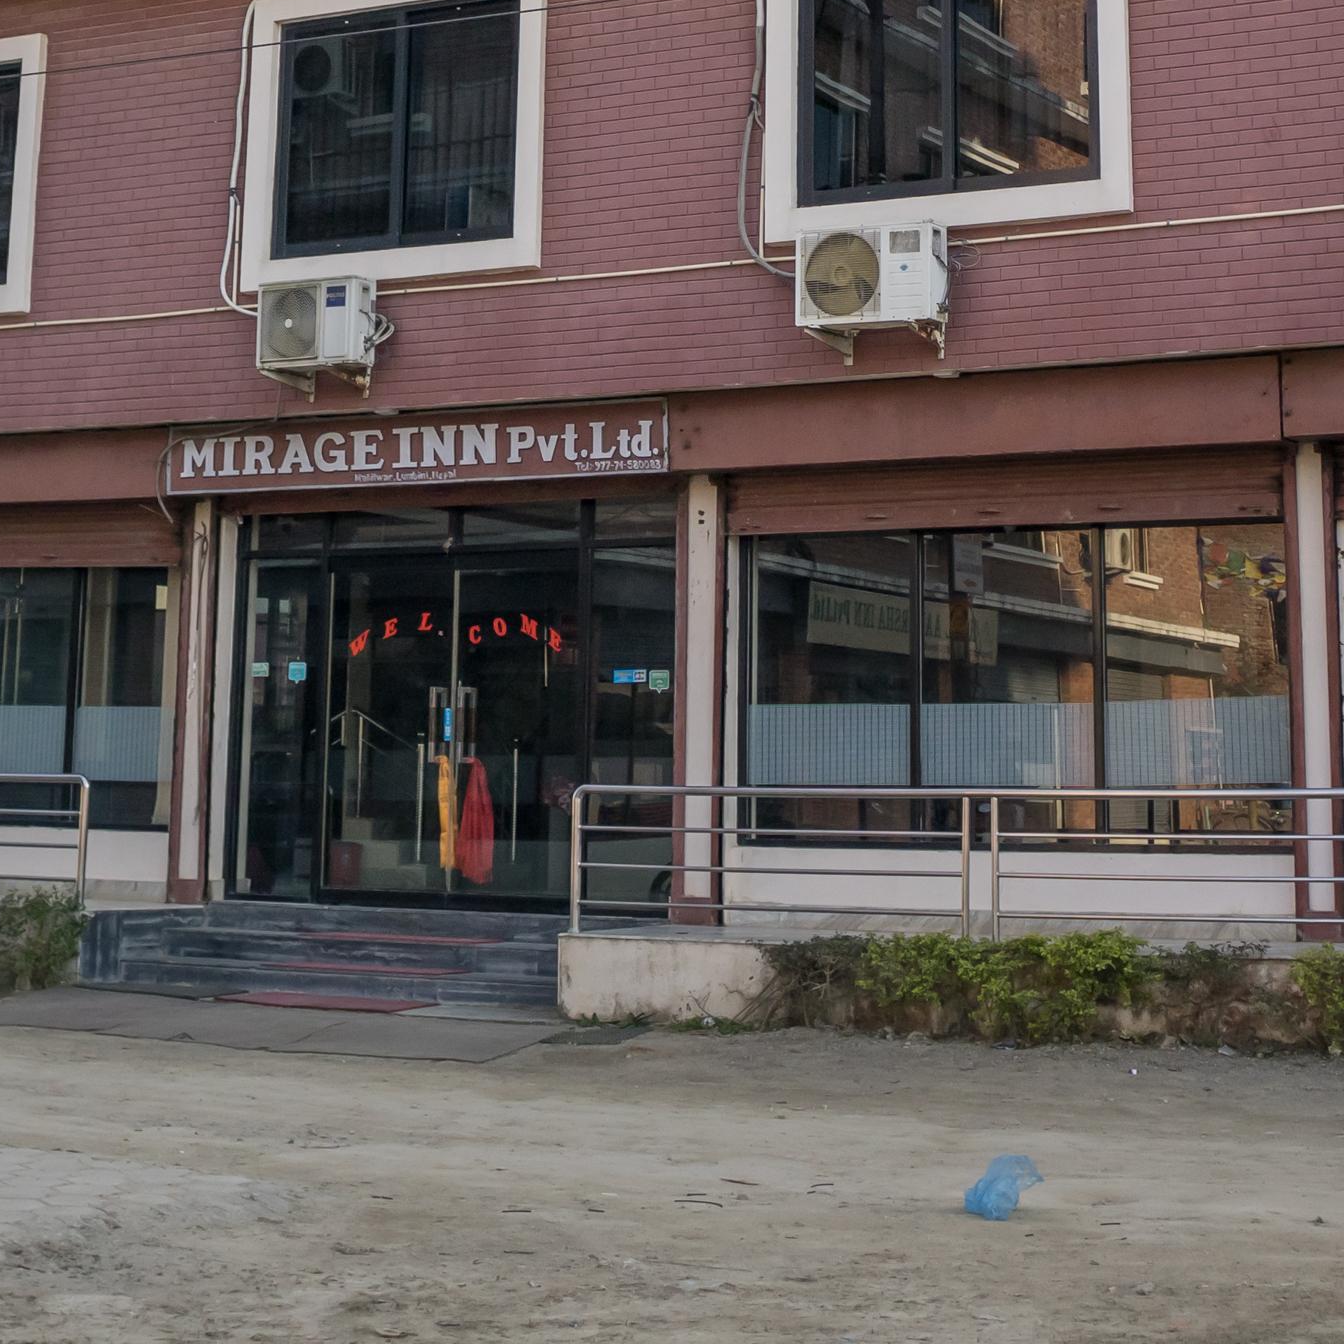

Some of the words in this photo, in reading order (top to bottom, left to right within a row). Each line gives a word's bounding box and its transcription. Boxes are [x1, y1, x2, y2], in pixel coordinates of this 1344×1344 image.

[180, 430, 384, 479] MIRAGE
[392, 424, 499, 470] INN
[506, 420, 659, 465] Pvt.Ltd.
